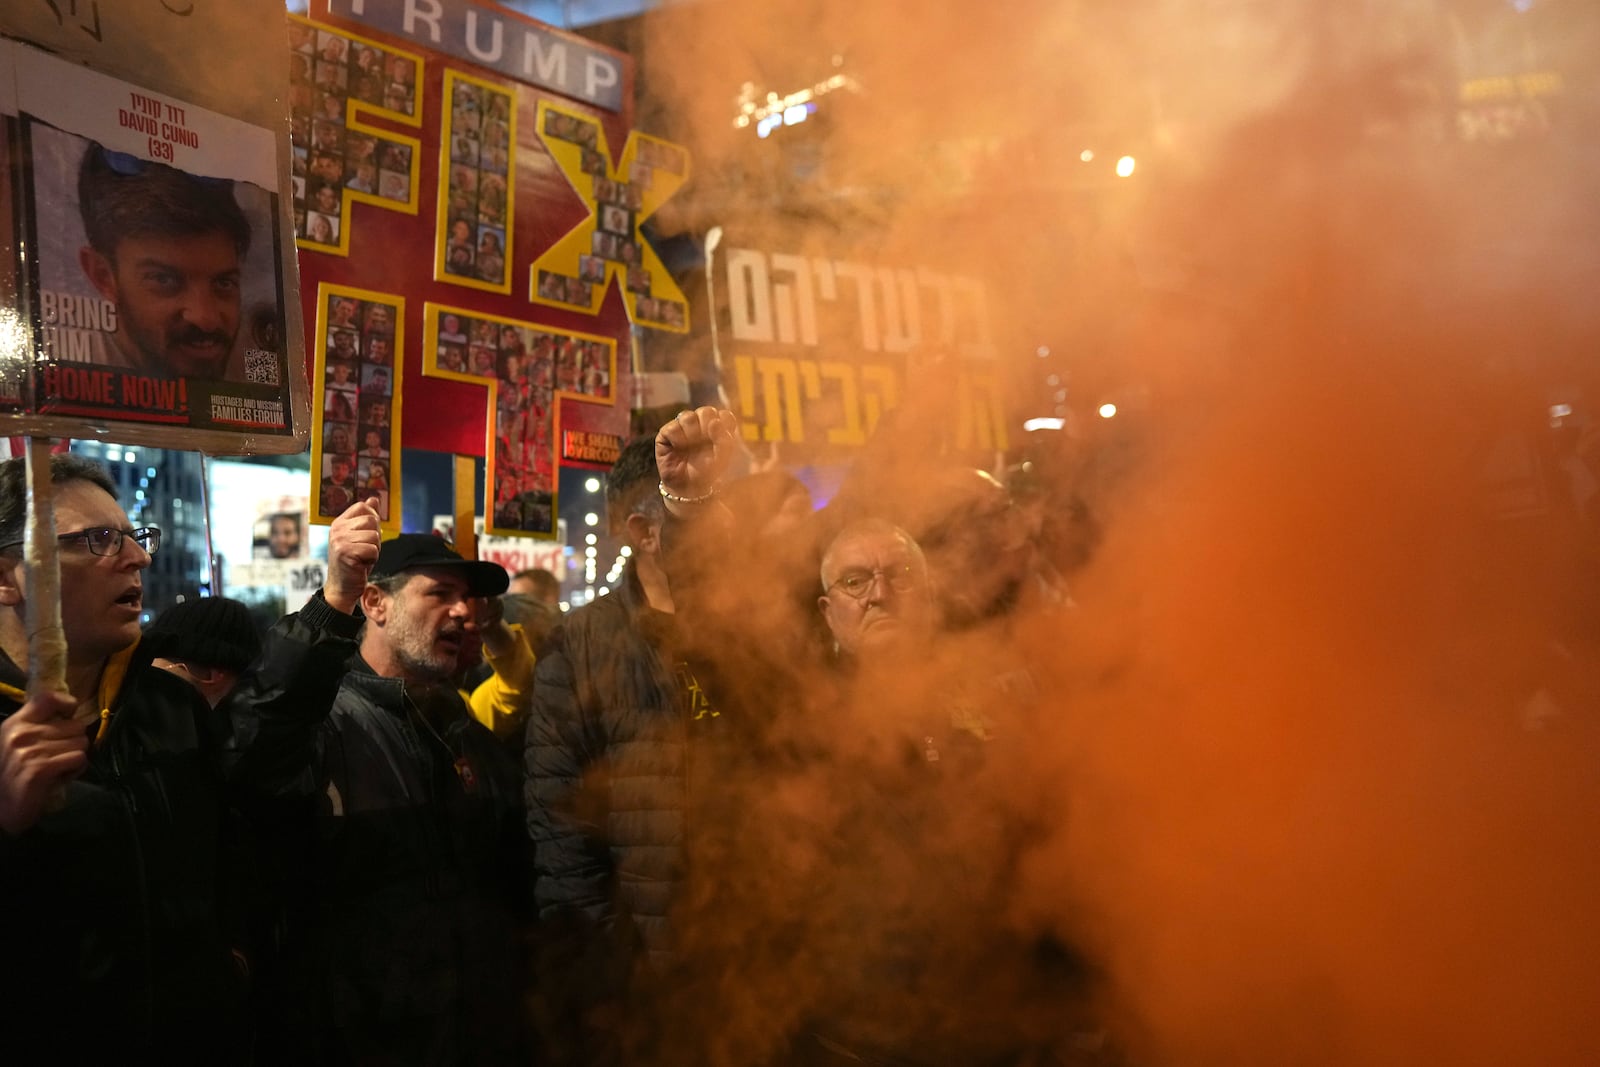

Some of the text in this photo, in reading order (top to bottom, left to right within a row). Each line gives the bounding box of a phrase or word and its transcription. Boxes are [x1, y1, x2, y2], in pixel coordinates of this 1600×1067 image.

[130, 92, 185, 126] דוד קוניו
[119, 108, 199, 149] DAVID CUNIO
[148, 136, 174, 163] (33)
[287, 14, 691, 334] FIX
[40, 288, 117, 332] BRING
[43, 327, 92, 363] HIM
[44, 366, 115, 404] HOME
[121, 373, 188, 411] NOW!
[210, 394, 284, 412] HOSTAGES AND MISSING
[211, 405, 285, 425] FAMILIES FORUM
[310, 280, 617, 541] IT
[566, 431, 620, 450] WE SHALL
